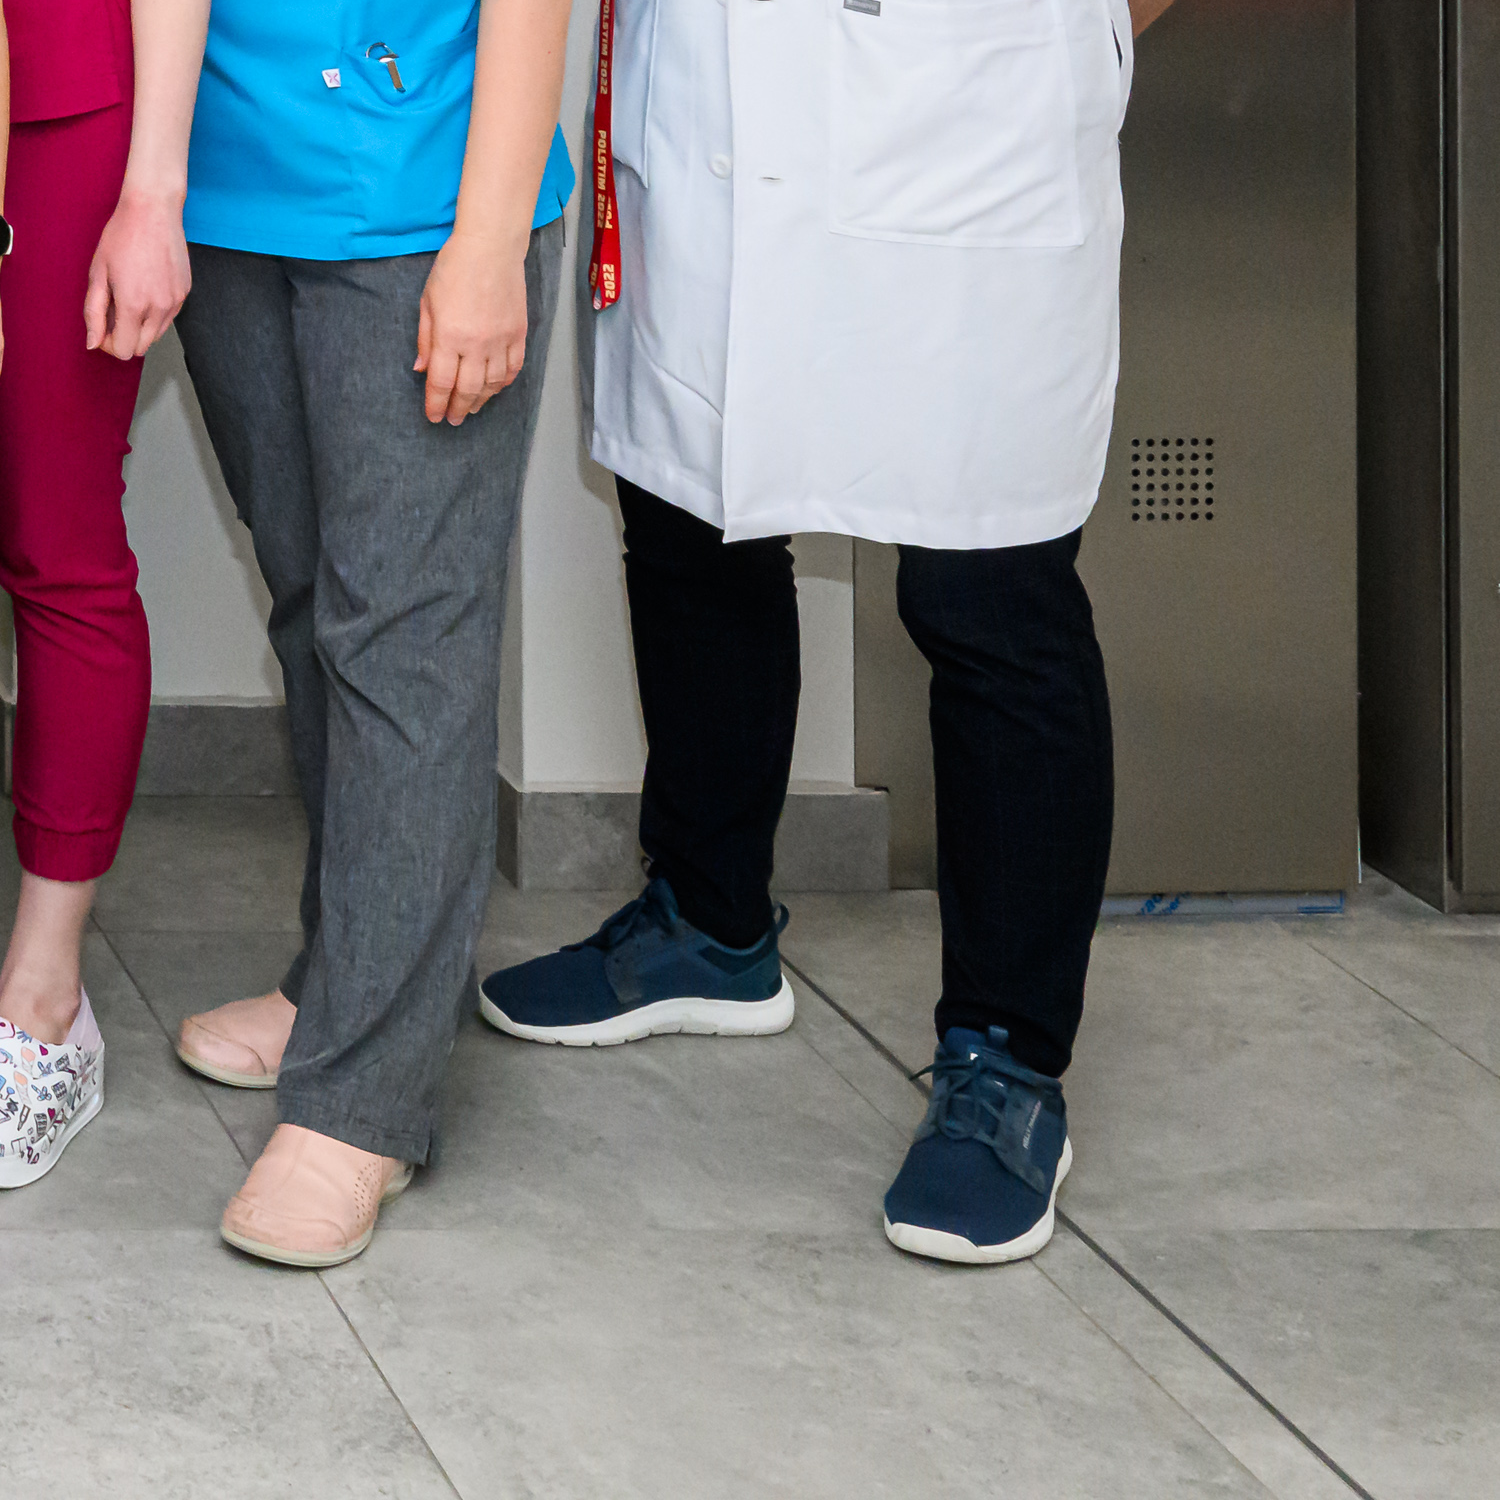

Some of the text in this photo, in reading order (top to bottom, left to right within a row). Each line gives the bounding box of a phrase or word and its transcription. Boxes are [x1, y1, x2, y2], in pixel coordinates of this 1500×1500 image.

[600, 59, 608, 95] 2022
[597, 129, 607, 229] POLSTIM 2022
[602, 263, 616, 299] 2022
